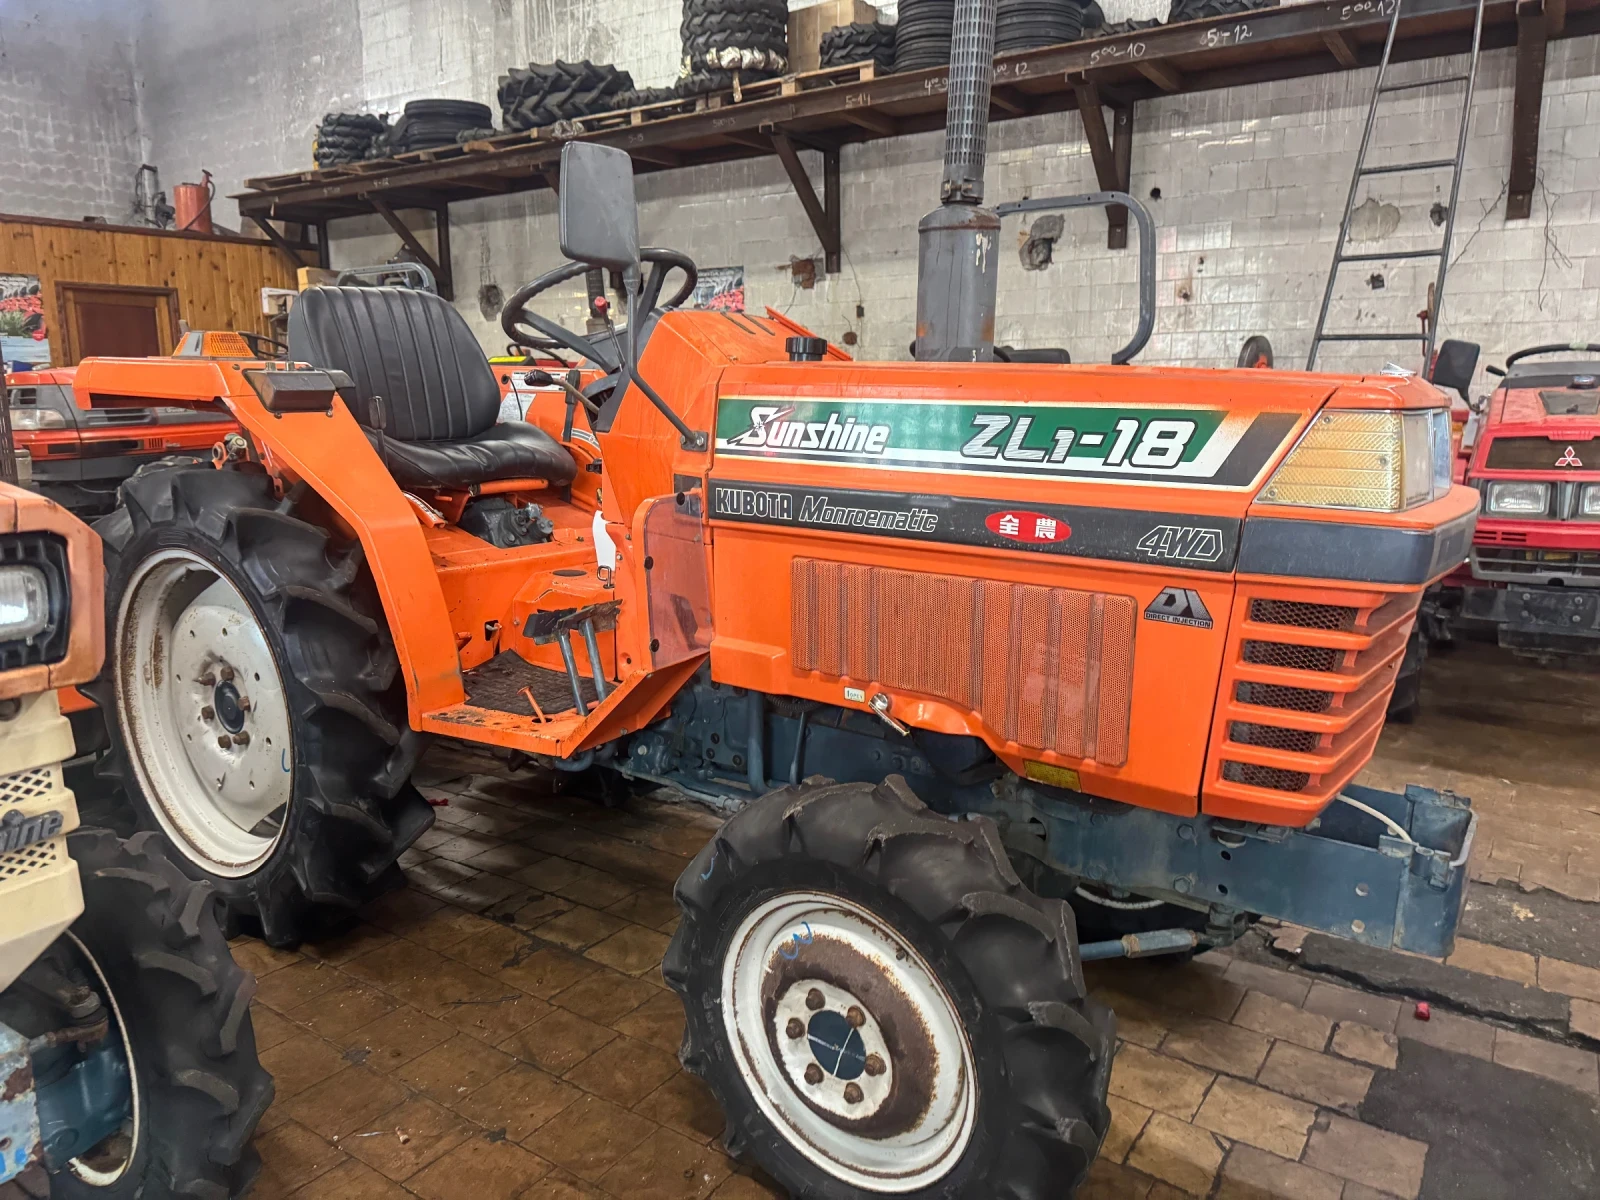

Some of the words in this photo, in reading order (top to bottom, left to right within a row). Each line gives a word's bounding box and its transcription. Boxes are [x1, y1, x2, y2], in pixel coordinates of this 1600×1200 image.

[727, 406, 891, 454] Sunshine
[960, 412, 1199, 470] ZL1-18
[715, 487, 793, 520] KUBOTA
[798, 495, 939, 533] Monroematic
[1136, 524, 1224, 562] 4WD
[1145, 611, 1171, 621] DIRECT
[1172, 616, 1211, 628] INJECTION
